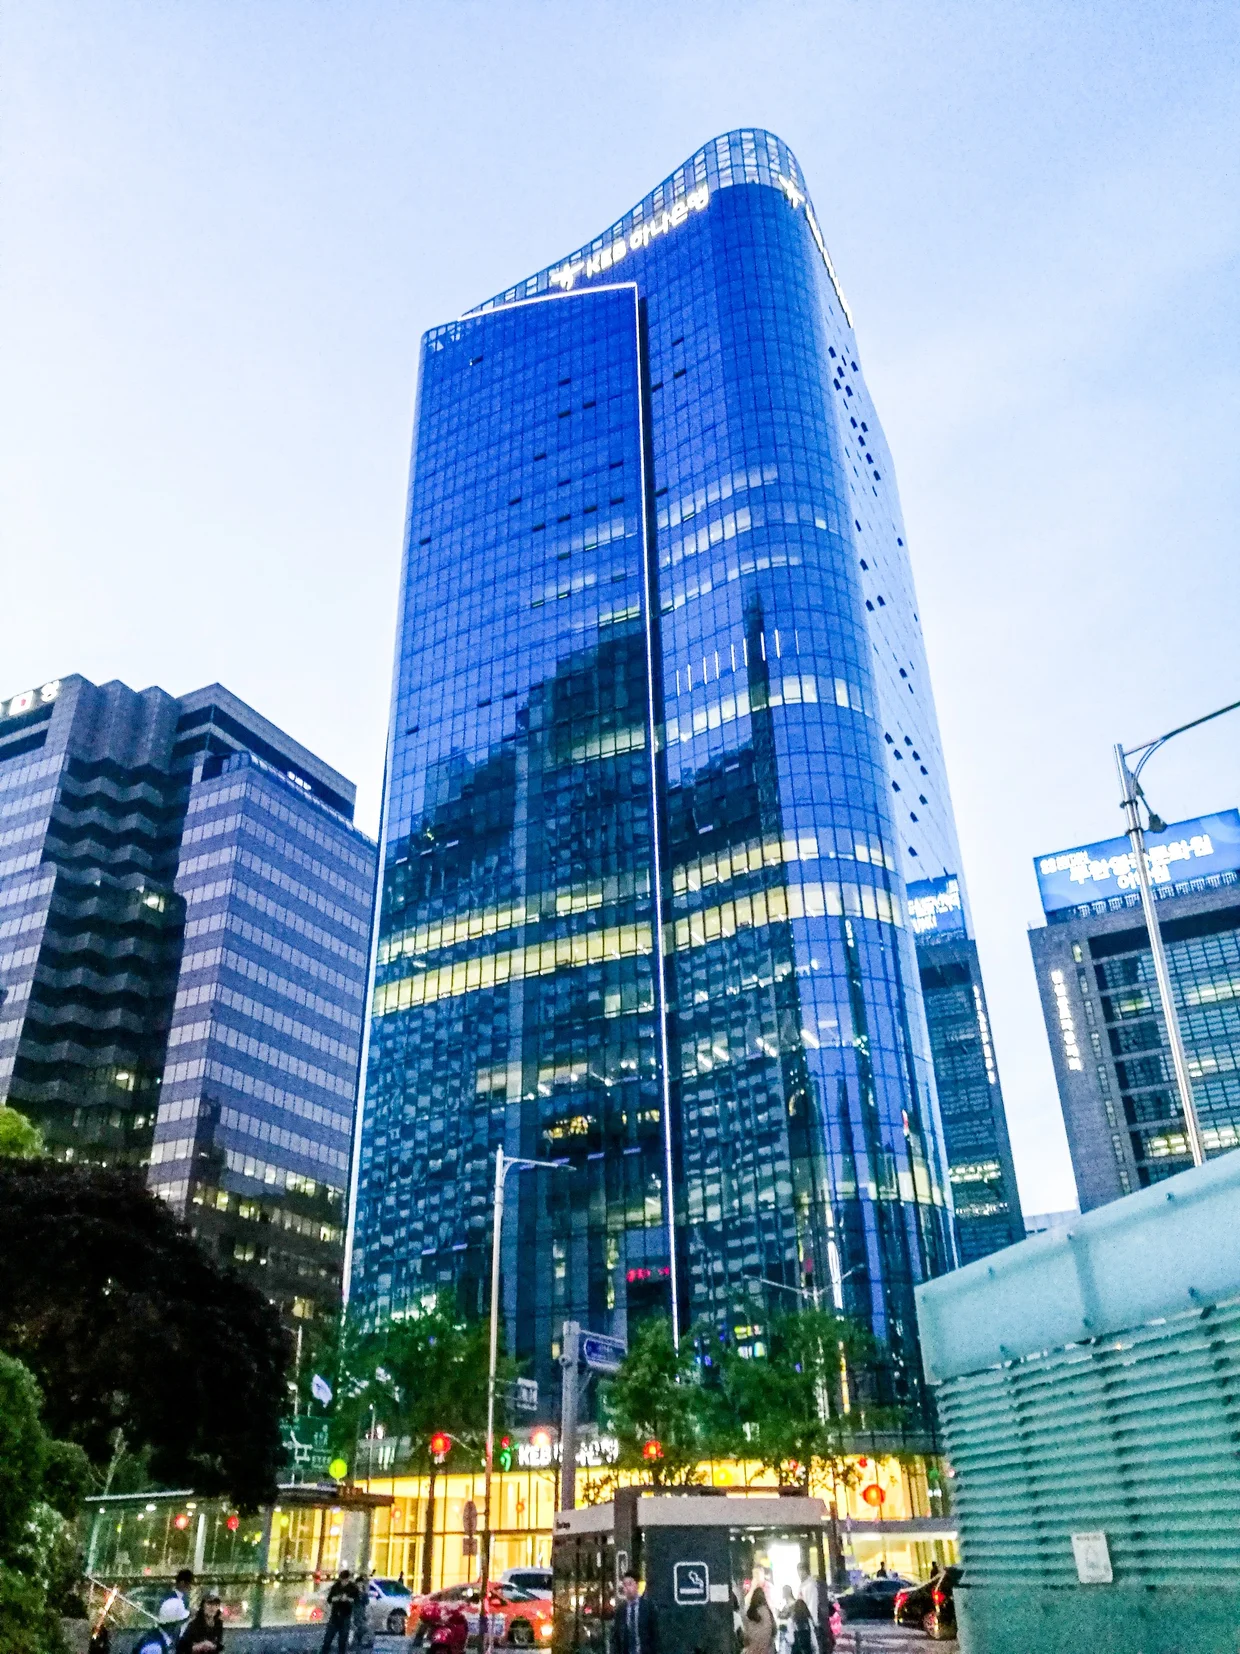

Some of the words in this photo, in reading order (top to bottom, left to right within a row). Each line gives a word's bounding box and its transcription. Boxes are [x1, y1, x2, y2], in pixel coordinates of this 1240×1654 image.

[586, 239, 627, 277] KEB
[629, 183, 709, 250] 하나은행
[518, 1443, 551, 1466] KEB
